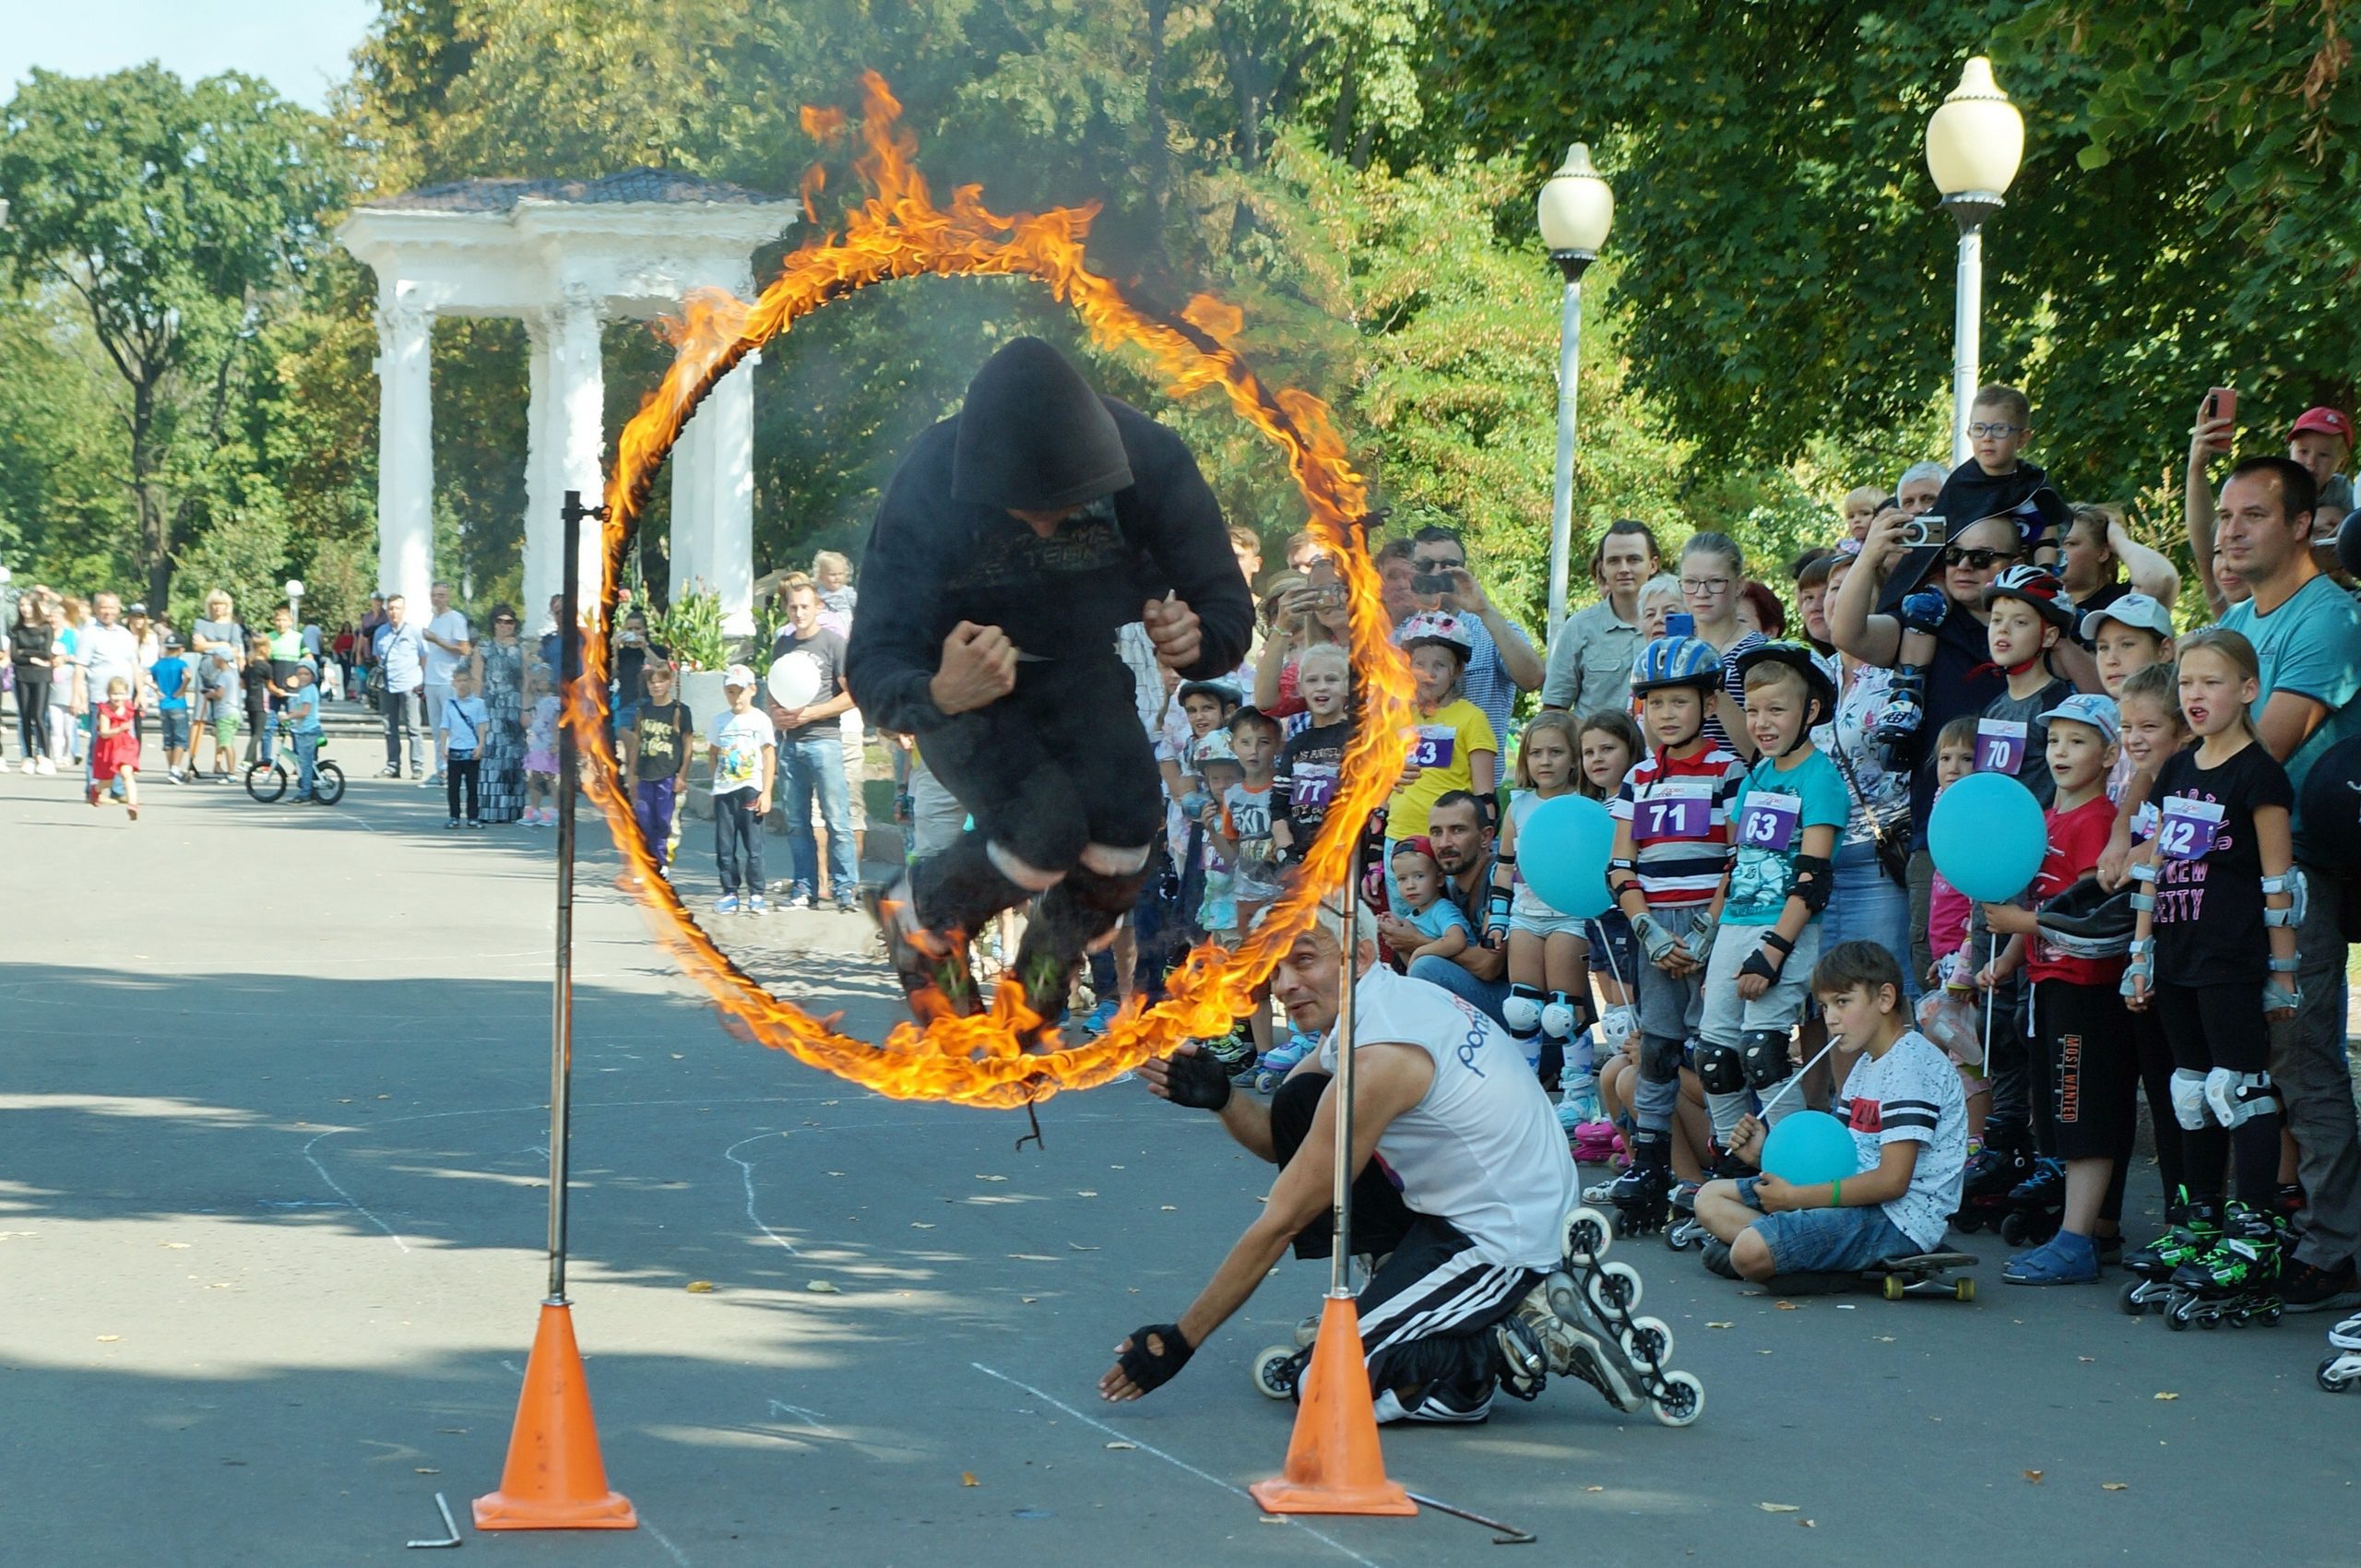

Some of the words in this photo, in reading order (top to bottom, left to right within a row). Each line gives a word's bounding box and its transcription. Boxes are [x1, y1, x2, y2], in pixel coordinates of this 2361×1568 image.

[1987, 741, 2011, 768] 70
[1298, 779, 1328, 802] 77
[1649, 803, 1686, 833] 71
[1745, 812, 1777, 841] 63
[2159, 820, 2195, 854] 42
[2064, 1037, 2080, 1070] MOST
[2062, 1075, 2077, 1121] WANTED
